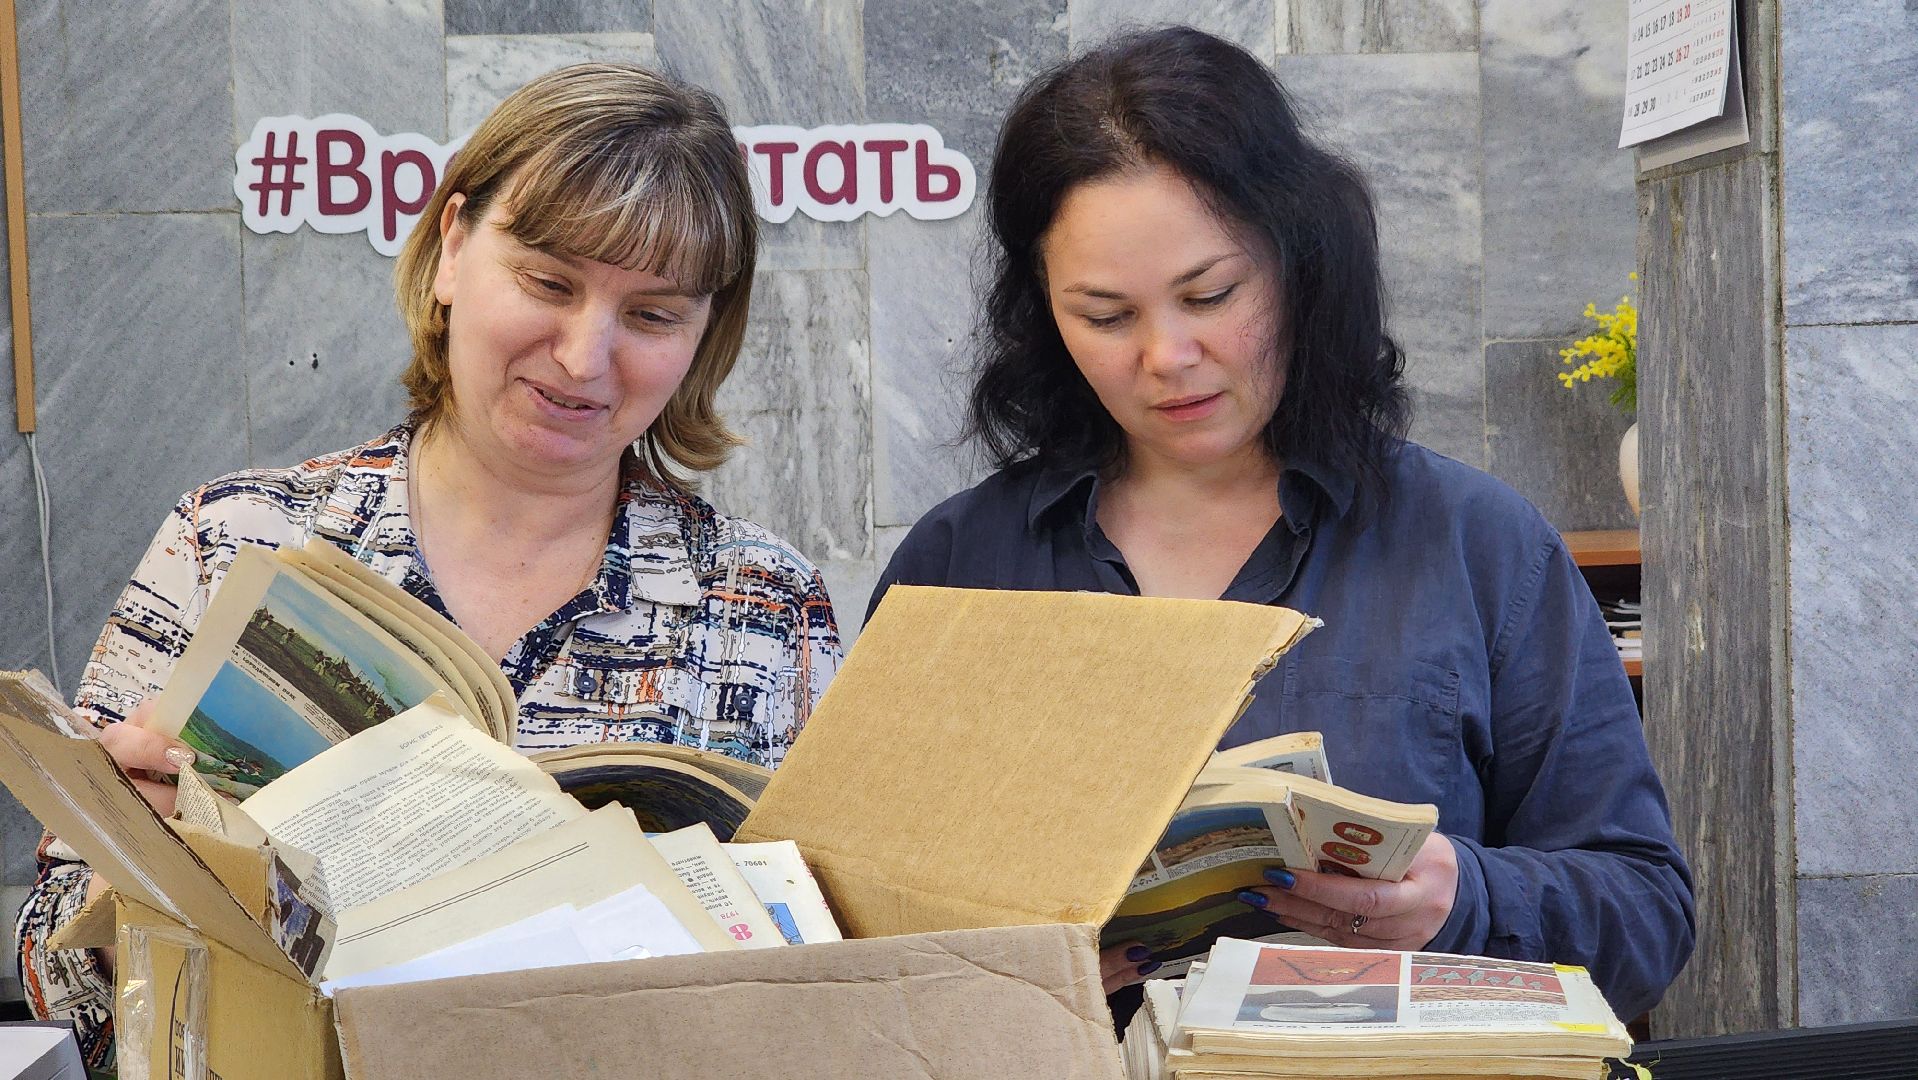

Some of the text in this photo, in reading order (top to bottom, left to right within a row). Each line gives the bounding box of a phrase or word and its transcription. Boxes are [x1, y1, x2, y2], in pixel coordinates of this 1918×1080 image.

[248, 129, 962, 241] #Вр тать
[720, 911, 740, 920] 1978
[729, 923, 753, 941] 8
